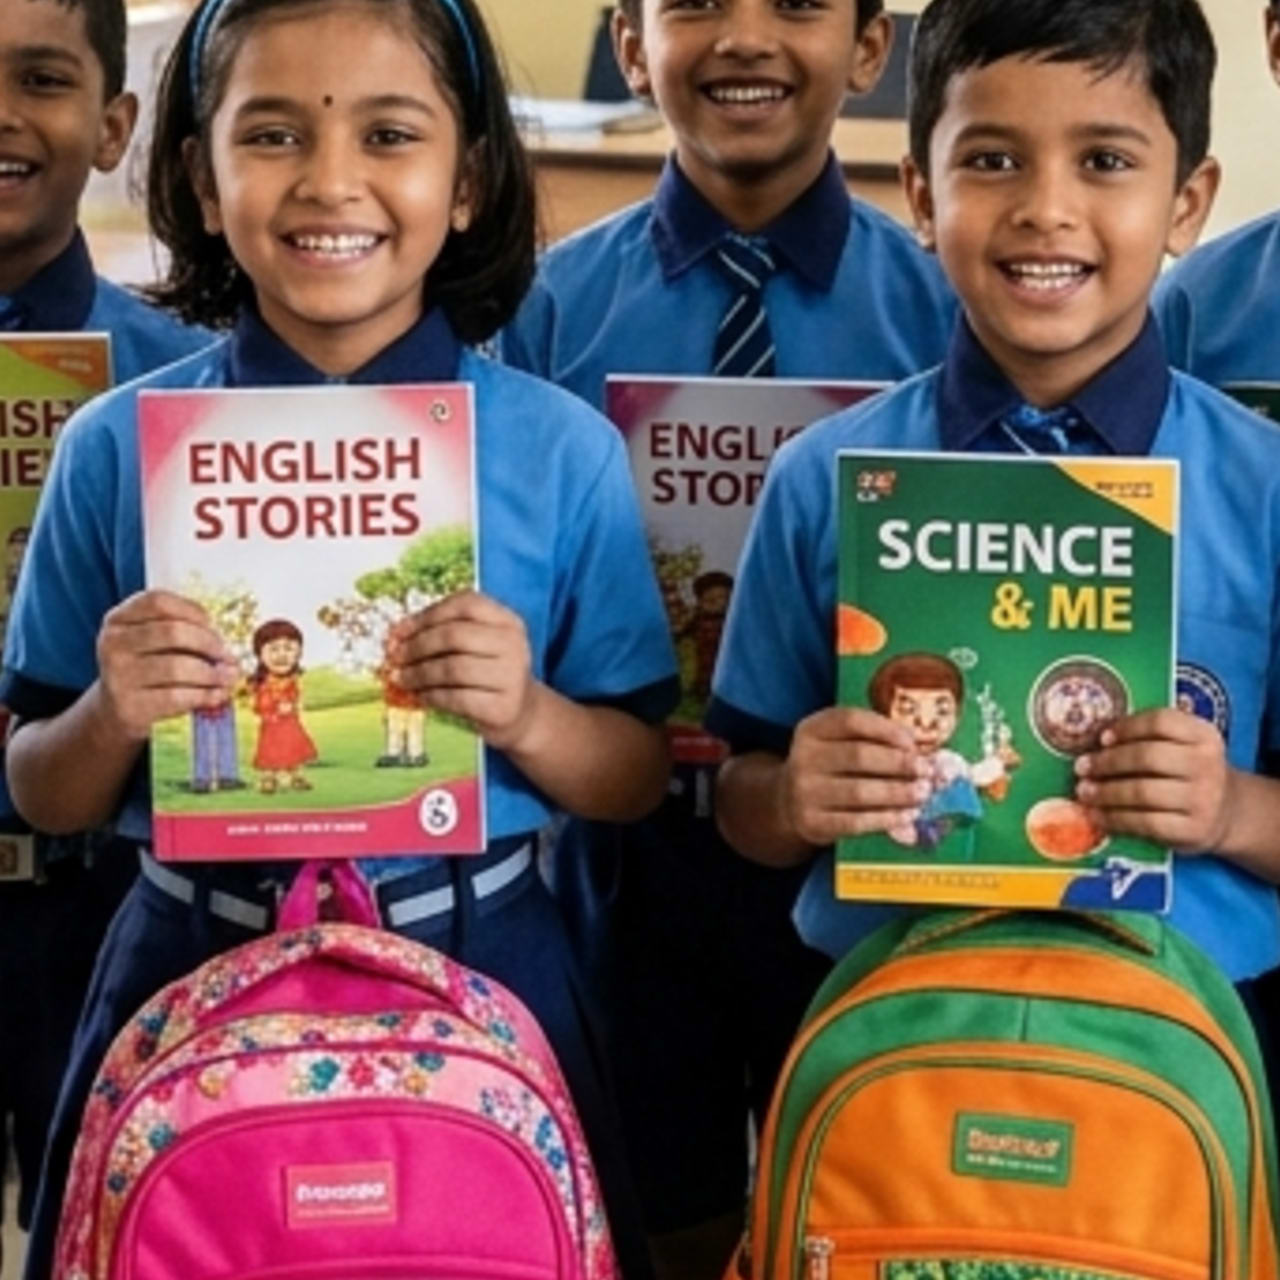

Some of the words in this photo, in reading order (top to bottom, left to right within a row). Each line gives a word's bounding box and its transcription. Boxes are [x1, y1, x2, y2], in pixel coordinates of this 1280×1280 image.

[189, 437, 421, 486] ENGLISH
[194, 492, 421, 541] STORIES
[878, 519, 1134, 578] SCIENCE
[991, 582, 1033, 630] &
[1048, 584, 1133, 631] ME
